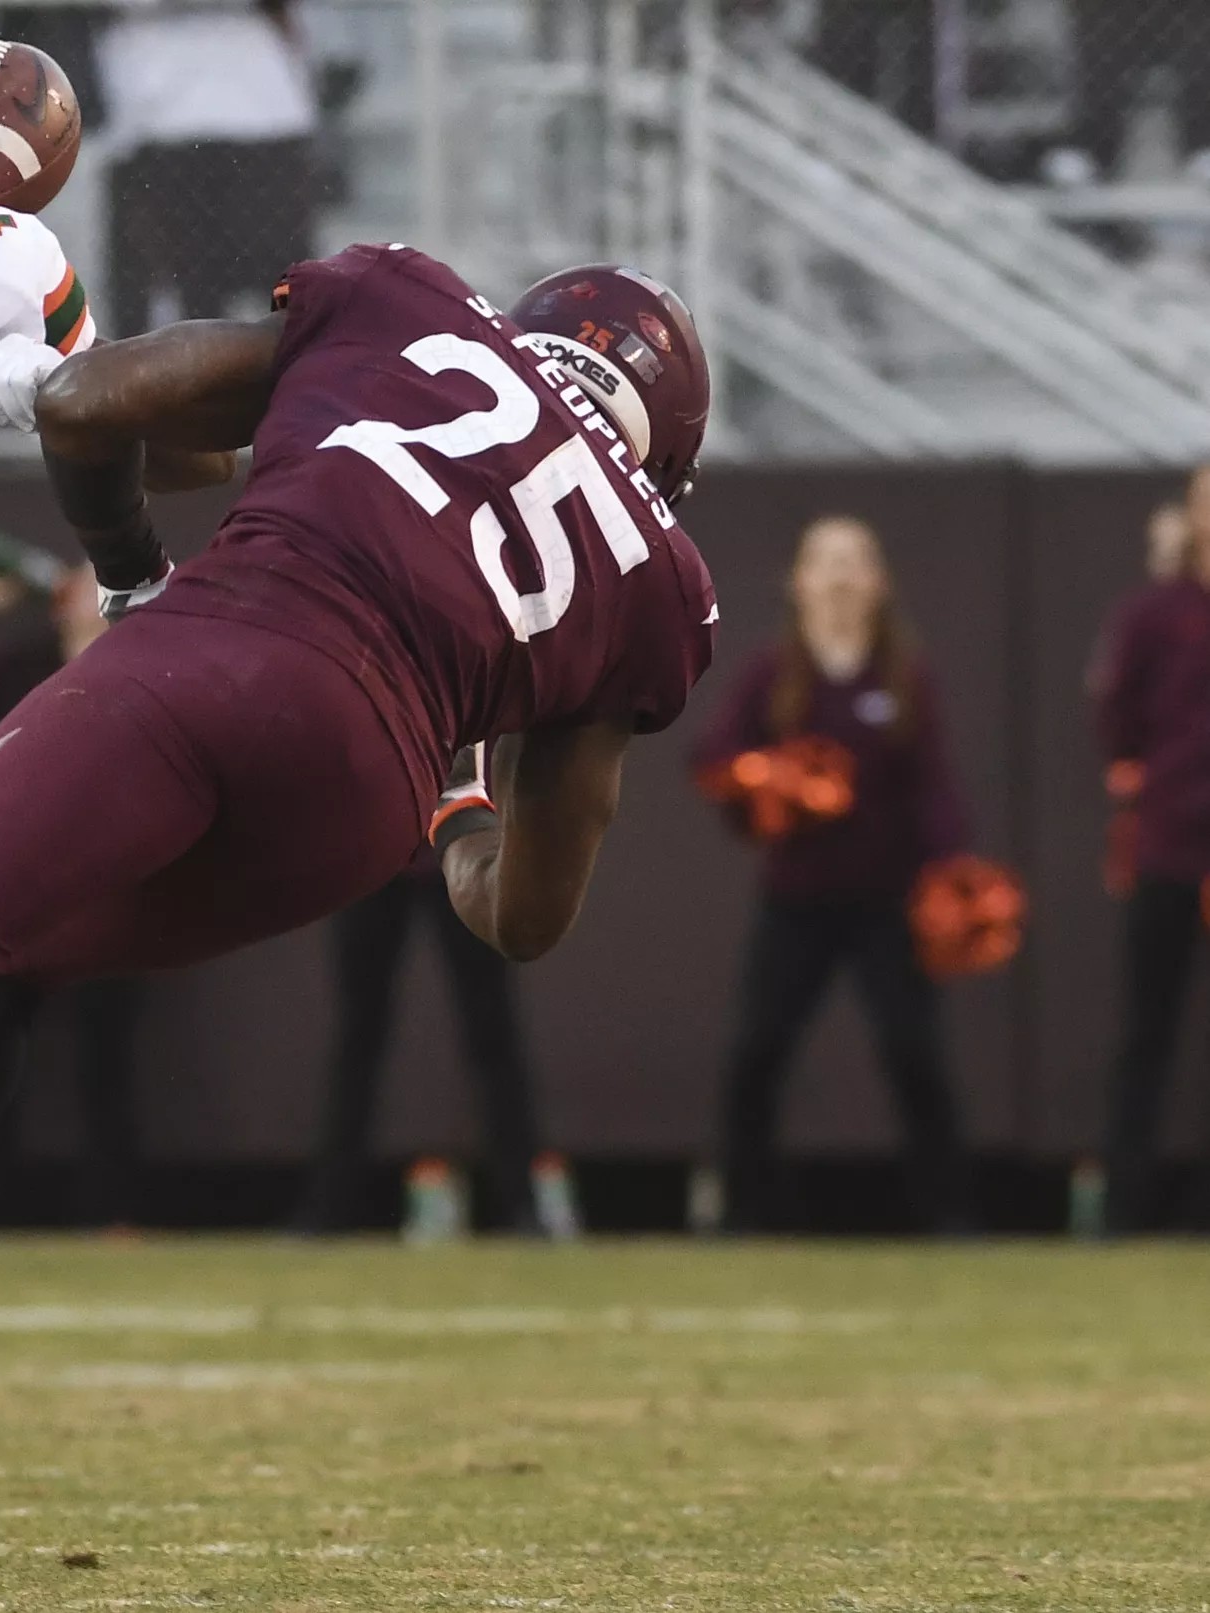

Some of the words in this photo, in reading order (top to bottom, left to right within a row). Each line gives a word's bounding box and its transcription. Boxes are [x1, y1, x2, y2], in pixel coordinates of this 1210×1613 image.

[511, 334, 675, 530] PEOPLES
[575, 320, 615, 353] 25
[316, 333, 650, 643] 25
